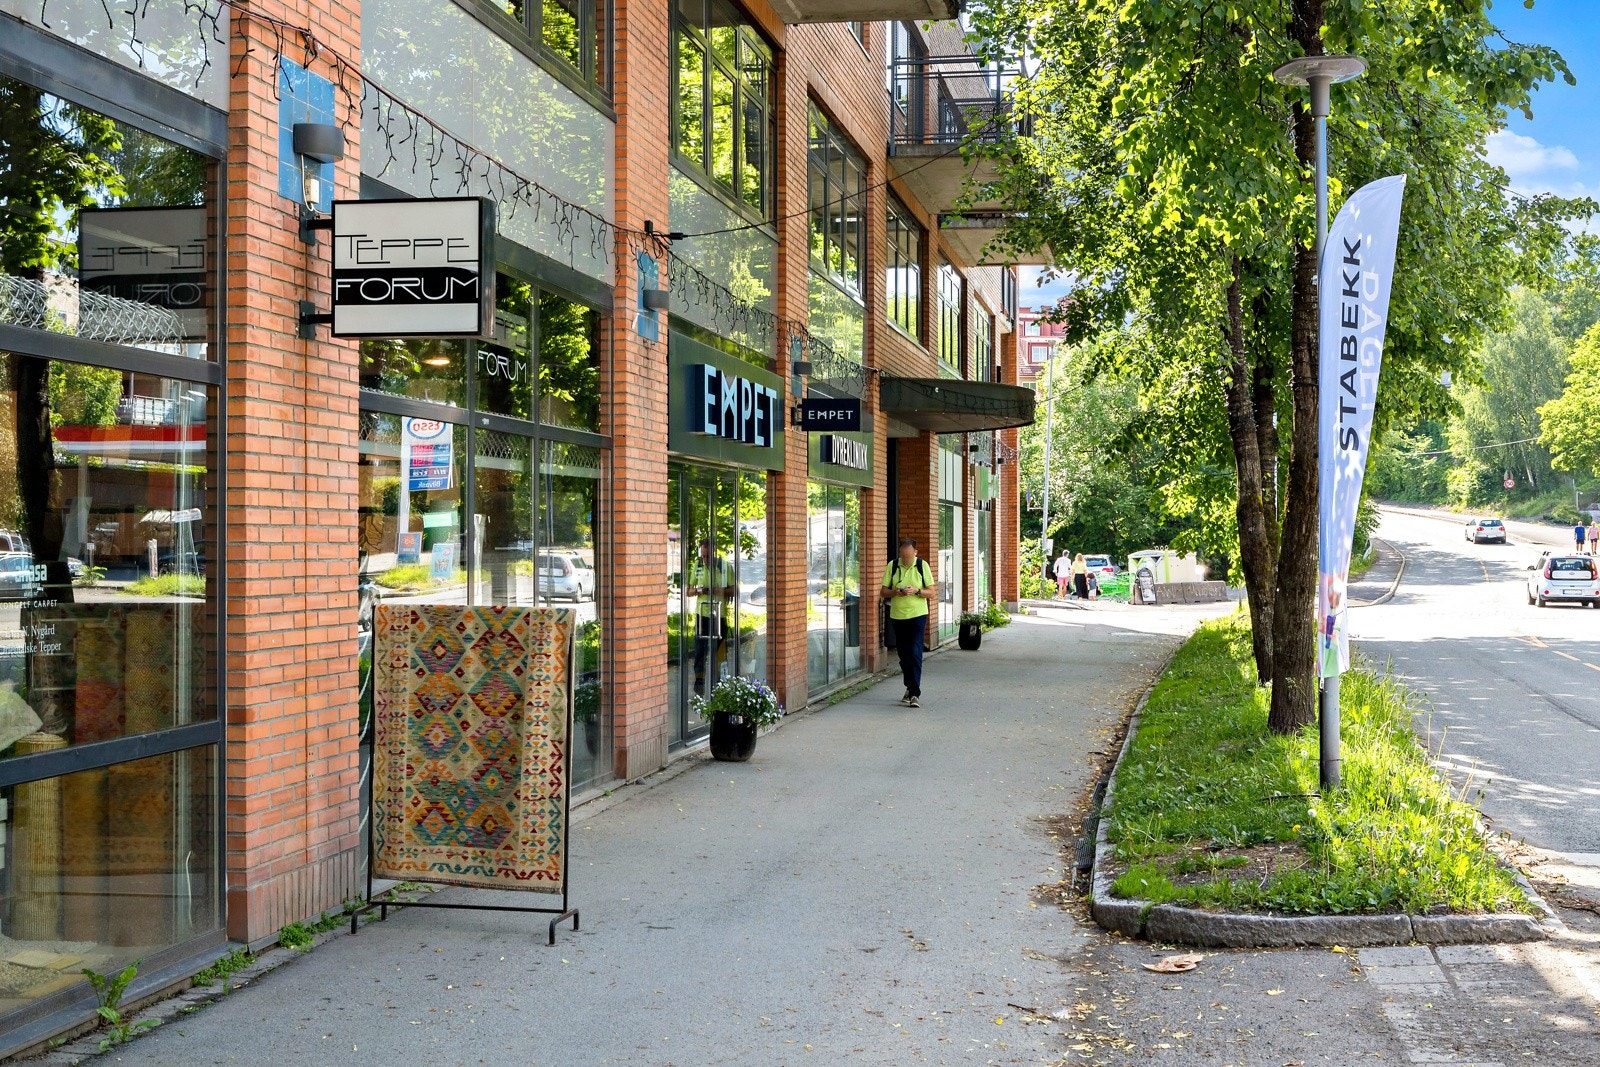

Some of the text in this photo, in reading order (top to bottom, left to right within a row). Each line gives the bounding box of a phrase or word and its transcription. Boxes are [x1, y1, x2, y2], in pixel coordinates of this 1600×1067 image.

[335, 234, 479, 264] TEPPE
[335, 276, 479, 301] FORUM
[1339, 236, 1362, 452] STABEKK
[477, 350, 527, 383] FORUM
[704, 363, 777, 449] EMPET
[808, 410, 854, 420] EMPET
[832, 434, 868, 471] DYREKLINIKK
[33, 599, 58, 608] CARPET
[39, 641, 61, 655] Tepper
